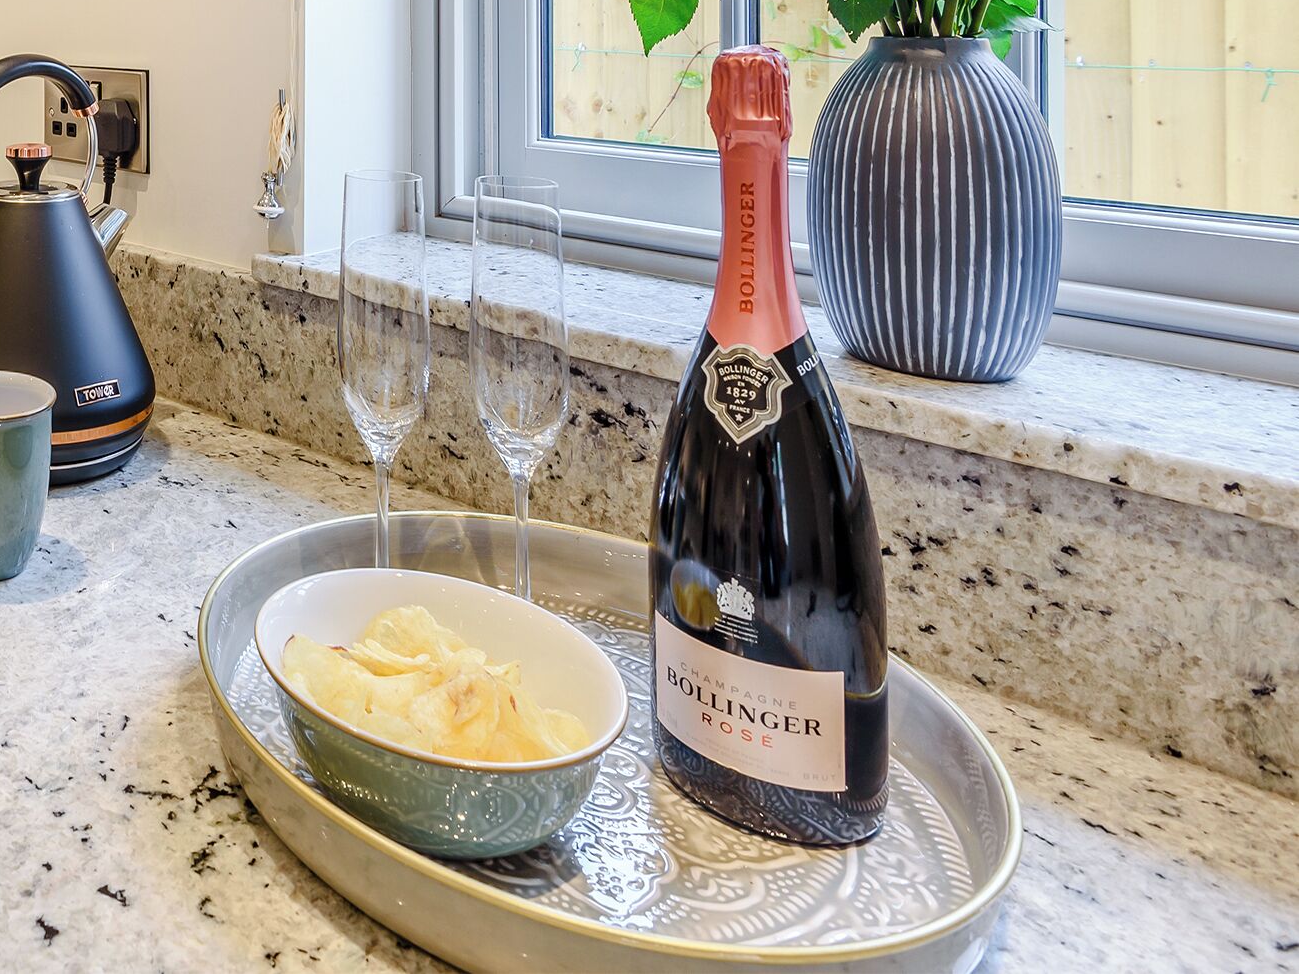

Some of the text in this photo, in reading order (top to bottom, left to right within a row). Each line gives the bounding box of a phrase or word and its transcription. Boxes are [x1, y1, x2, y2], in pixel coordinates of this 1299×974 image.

[738, 181, 755, 315] BOLLINGER
[718, 364, 769, 385] BOLLINGER
[726, 386, 757, 401] 1829
[729, 404, 751, 414] FRANCE
[680, 661, 798, 711] CHAMPAGNE
[667, 665, 822, 737] BOLLINGER
[701, 711, 774, 749] ROSÉ
[802, 771, 838, 782] BRUT
